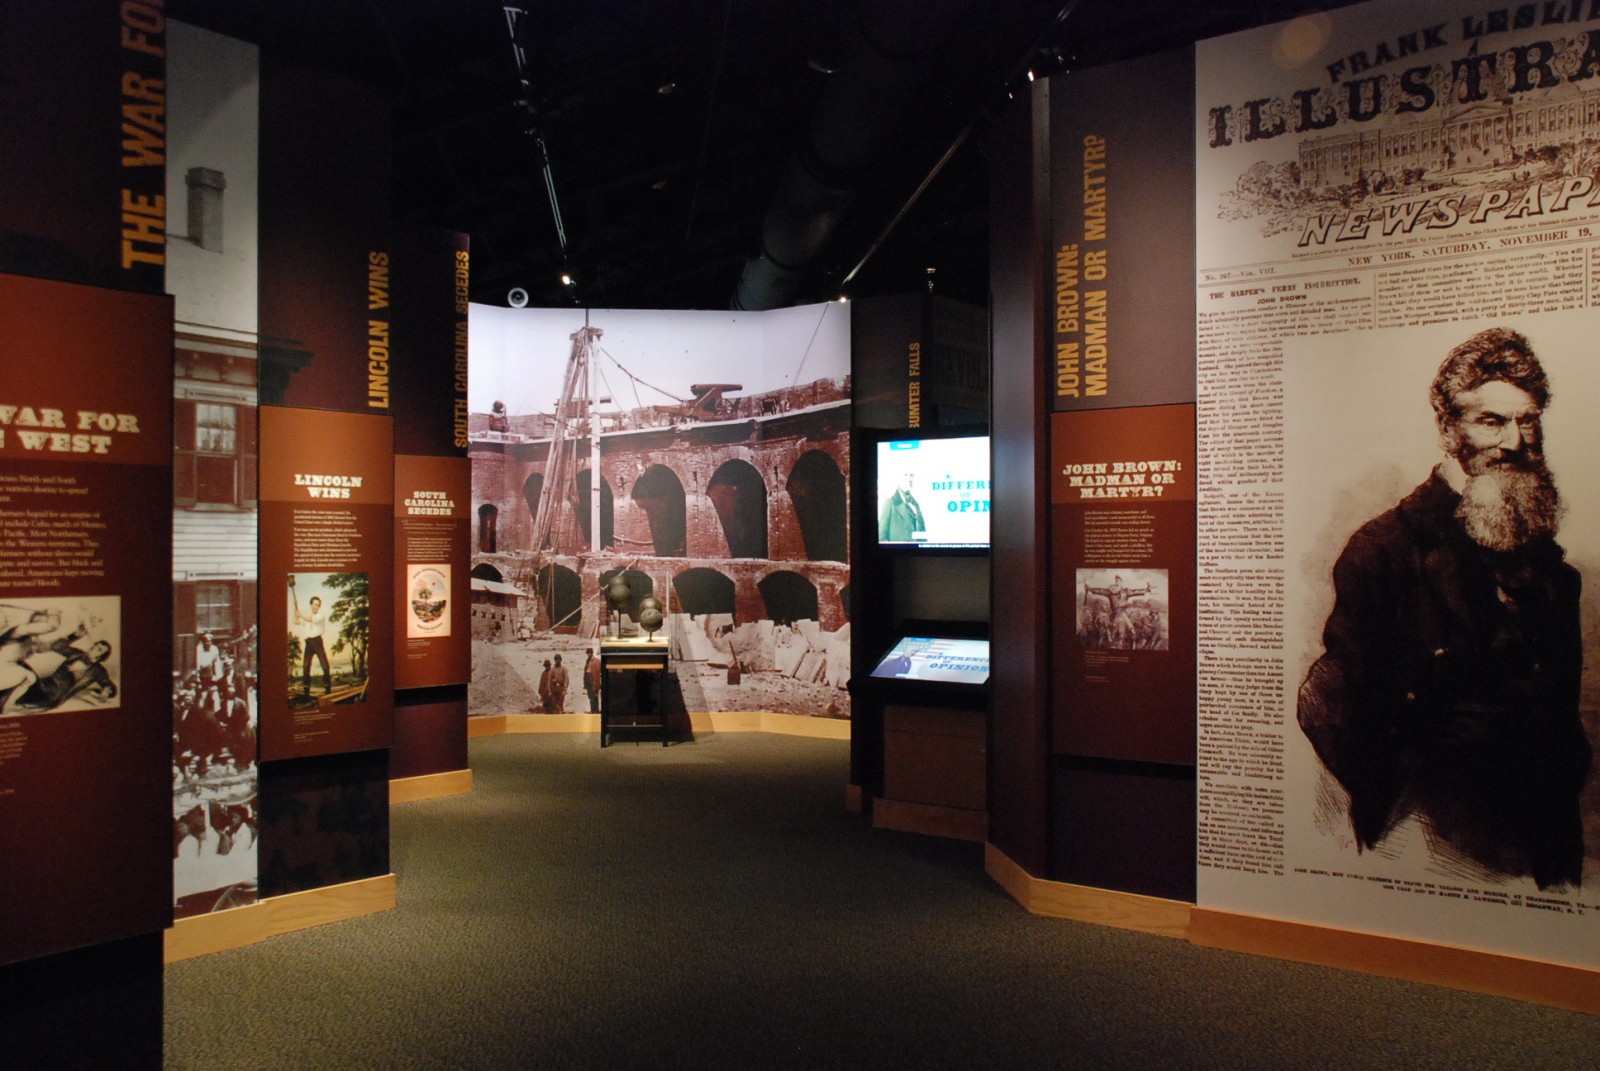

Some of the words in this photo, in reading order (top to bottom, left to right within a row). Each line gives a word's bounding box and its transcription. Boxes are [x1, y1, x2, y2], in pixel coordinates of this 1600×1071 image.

[122, 0, 166, 56] FO
[1326, 23, 1448, 83] FRANK
[122, 71, 166, 167] WAR
[1083, 134, 1107, 241] MARTYR?
[122, 188, 166, 269] THE
[1084, 249, 1107, 281] OR
[1348, 256, 1373, 266] NEW
[1422, 241, 1491, 256] SATURDAY,
[1500, 231, 1568, 248] NOVEMBER
[368, 251, 390, 310] WINS
[456, 250, 470, 313] SECEDES
[1057, 244, 1079, 333] BROWN:
[1272, 284, 1296, 292] FERRY
[1559, 286, 1582, 294] started
[1422, 318, 1448, 326] promises
[454, 322, 468, 392] CAROLINA
[909, 342, 920, 376] FALLS
[1085, 289, 1107, 397] MADMAN
[368, 320, 390, 409] LINCOLN
[1057, 342, 1079, 398] JOHN
[909, 381, 920, 428] SUMTER
[78, 411, 140, 434] FOR
[454, 398, 468, 448] SOUTH
[17, 430, 112, 454] WEST
[294, 474, 362, 487] LINCOLN
[1062, 463, 1108, 475] JOHN
[1112, 460, 1182, 473] BROWN:
[1070, 474, 1146, 487] MADMAN
[1150, 473, 1175, 484] OR
[307, 487, 351, 498] WINS
[404, 499, 455, 508] CAROLINA
[414, 491, 446, 499] SOUTH
[1080, 486, 1164, 498] MARTYR?
[408, 507, 452, 516] SECEDES
